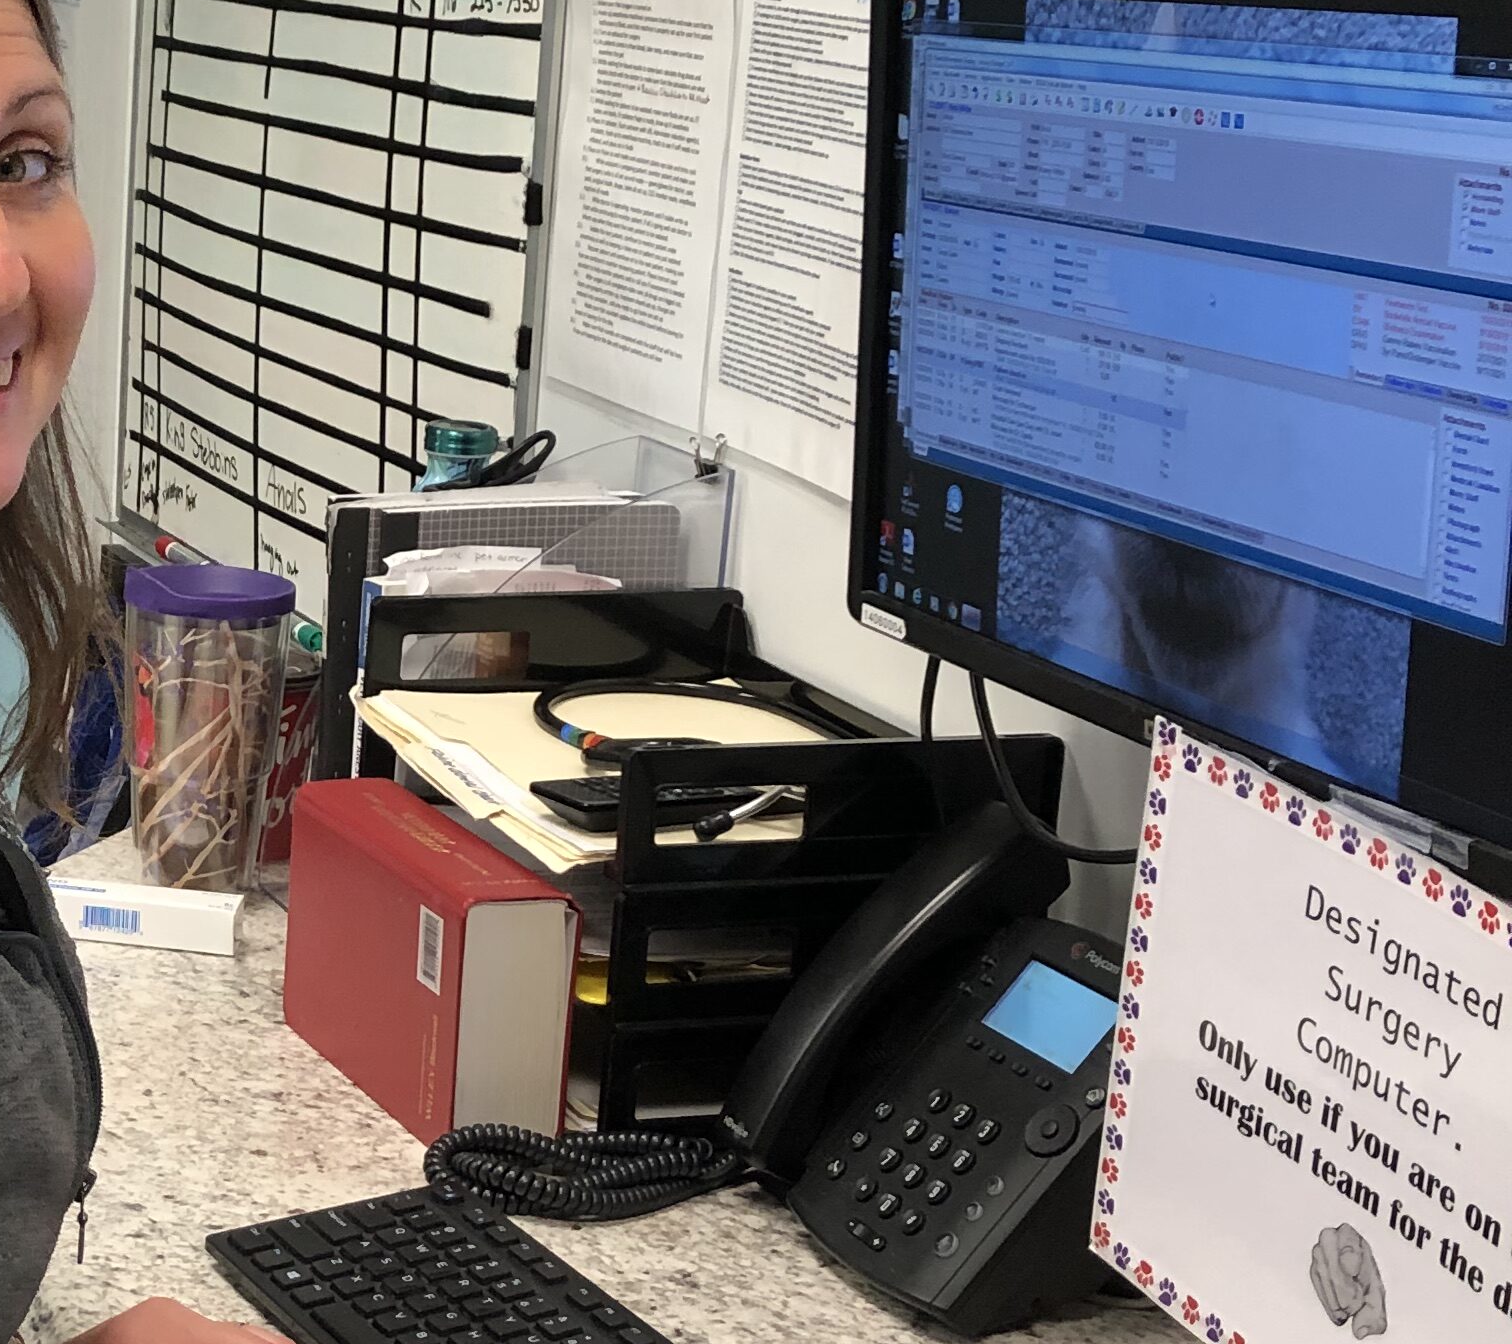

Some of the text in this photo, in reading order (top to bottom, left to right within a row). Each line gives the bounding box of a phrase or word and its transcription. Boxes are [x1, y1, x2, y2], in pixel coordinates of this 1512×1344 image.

[1084, 950, 1121, 975] Polycom
[1305, 885, 1503, 1030] Designated
[1325, 965, 1461, 1078] Surgery
[1198, 1020, 1502, 1247] Only use if you are on
[1297, 1017, 1462, 1152] Computer.
[1195, 1075, 1512, 1319] surgical team for the d
